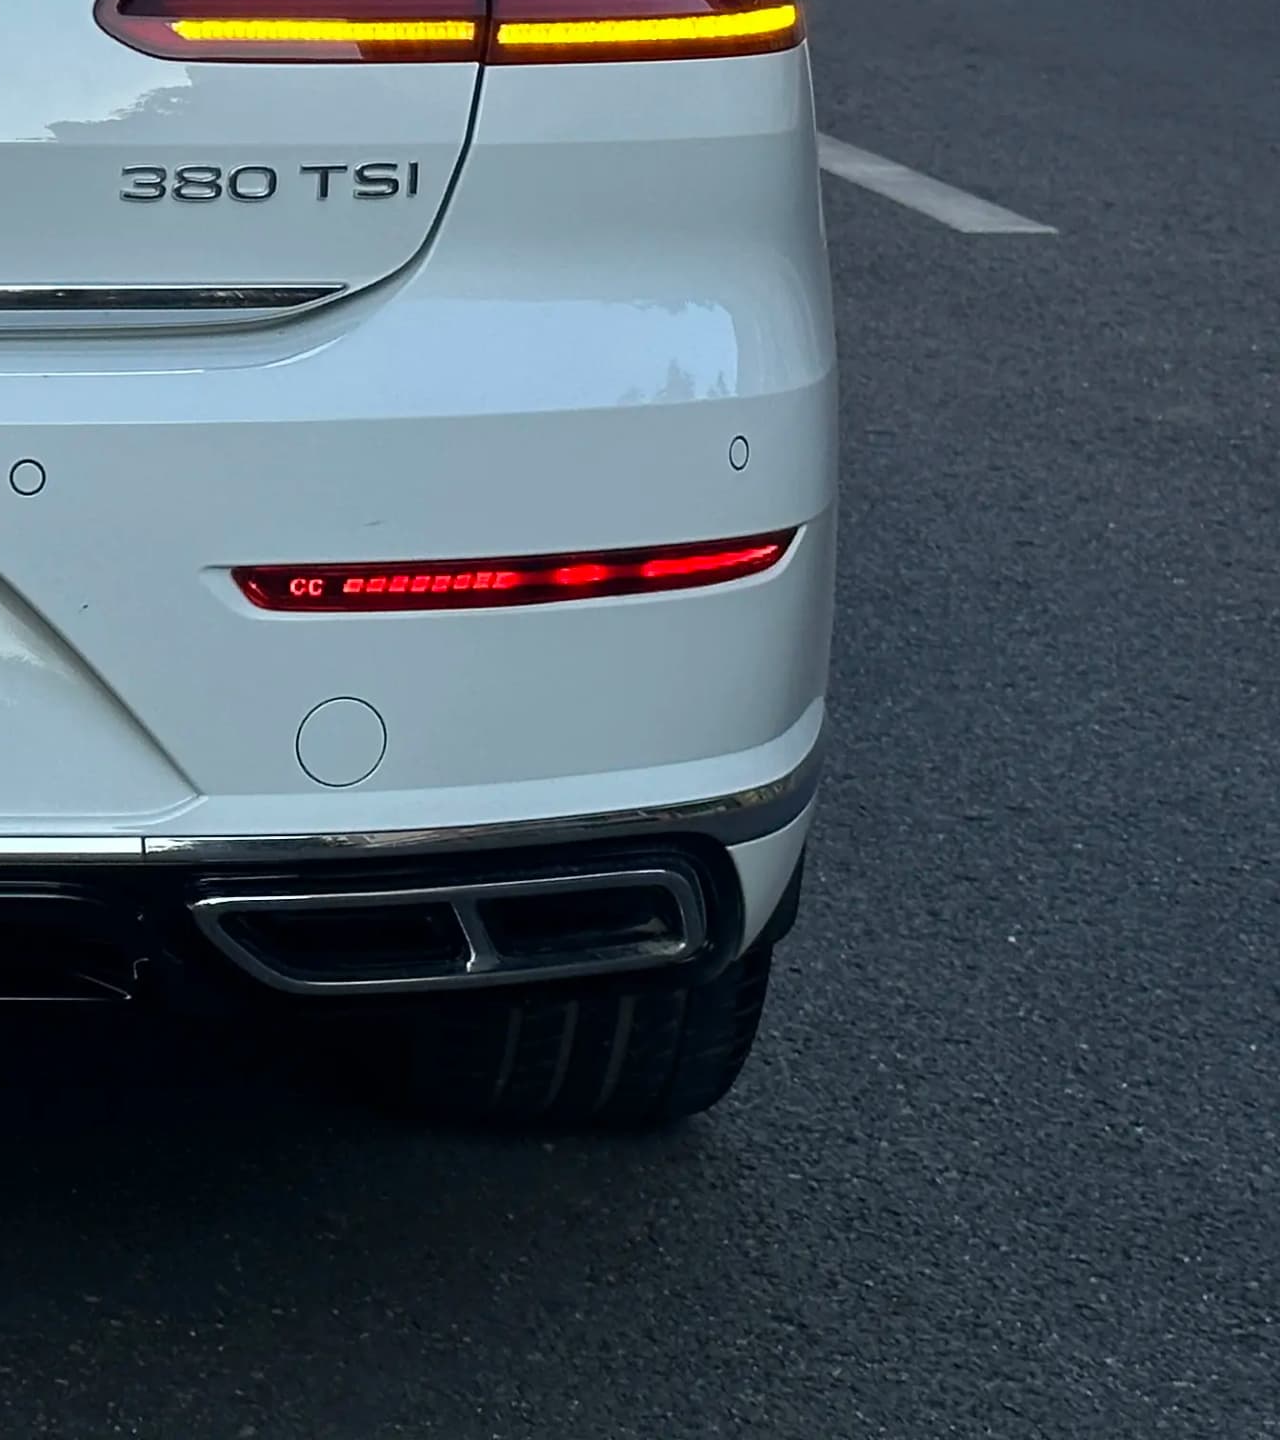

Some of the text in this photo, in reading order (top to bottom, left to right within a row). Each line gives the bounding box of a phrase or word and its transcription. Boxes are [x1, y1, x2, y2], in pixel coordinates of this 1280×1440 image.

[119, 160, 420, 203] 380 TSI
[290, 578, 323, 596] CC
